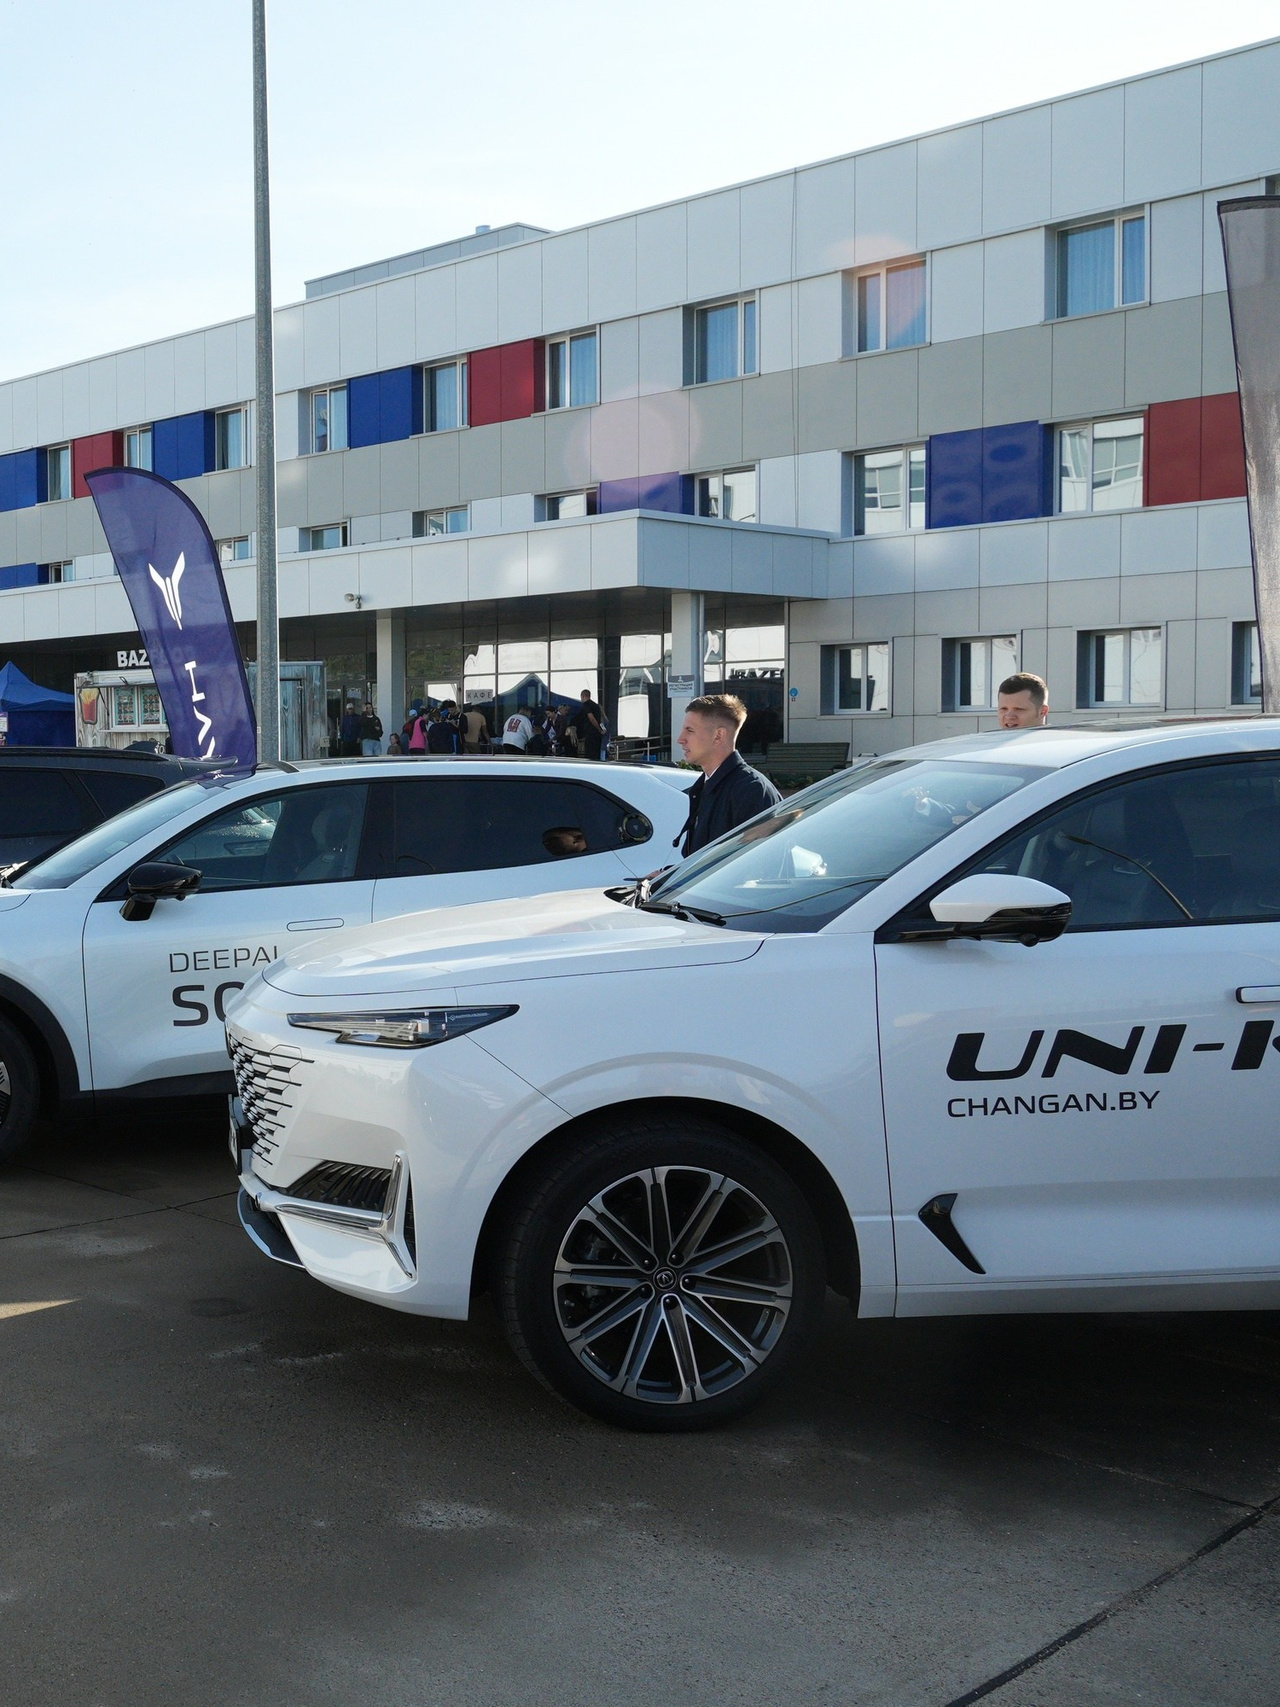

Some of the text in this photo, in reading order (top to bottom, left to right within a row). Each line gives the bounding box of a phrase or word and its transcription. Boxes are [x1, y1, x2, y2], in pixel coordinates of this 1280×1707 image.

[117, 649, 150, 668] BAZ
[467, 691, 491, 699] КАФЕ
[947, 1090, 1161, 1118] CHANGAN.BY
